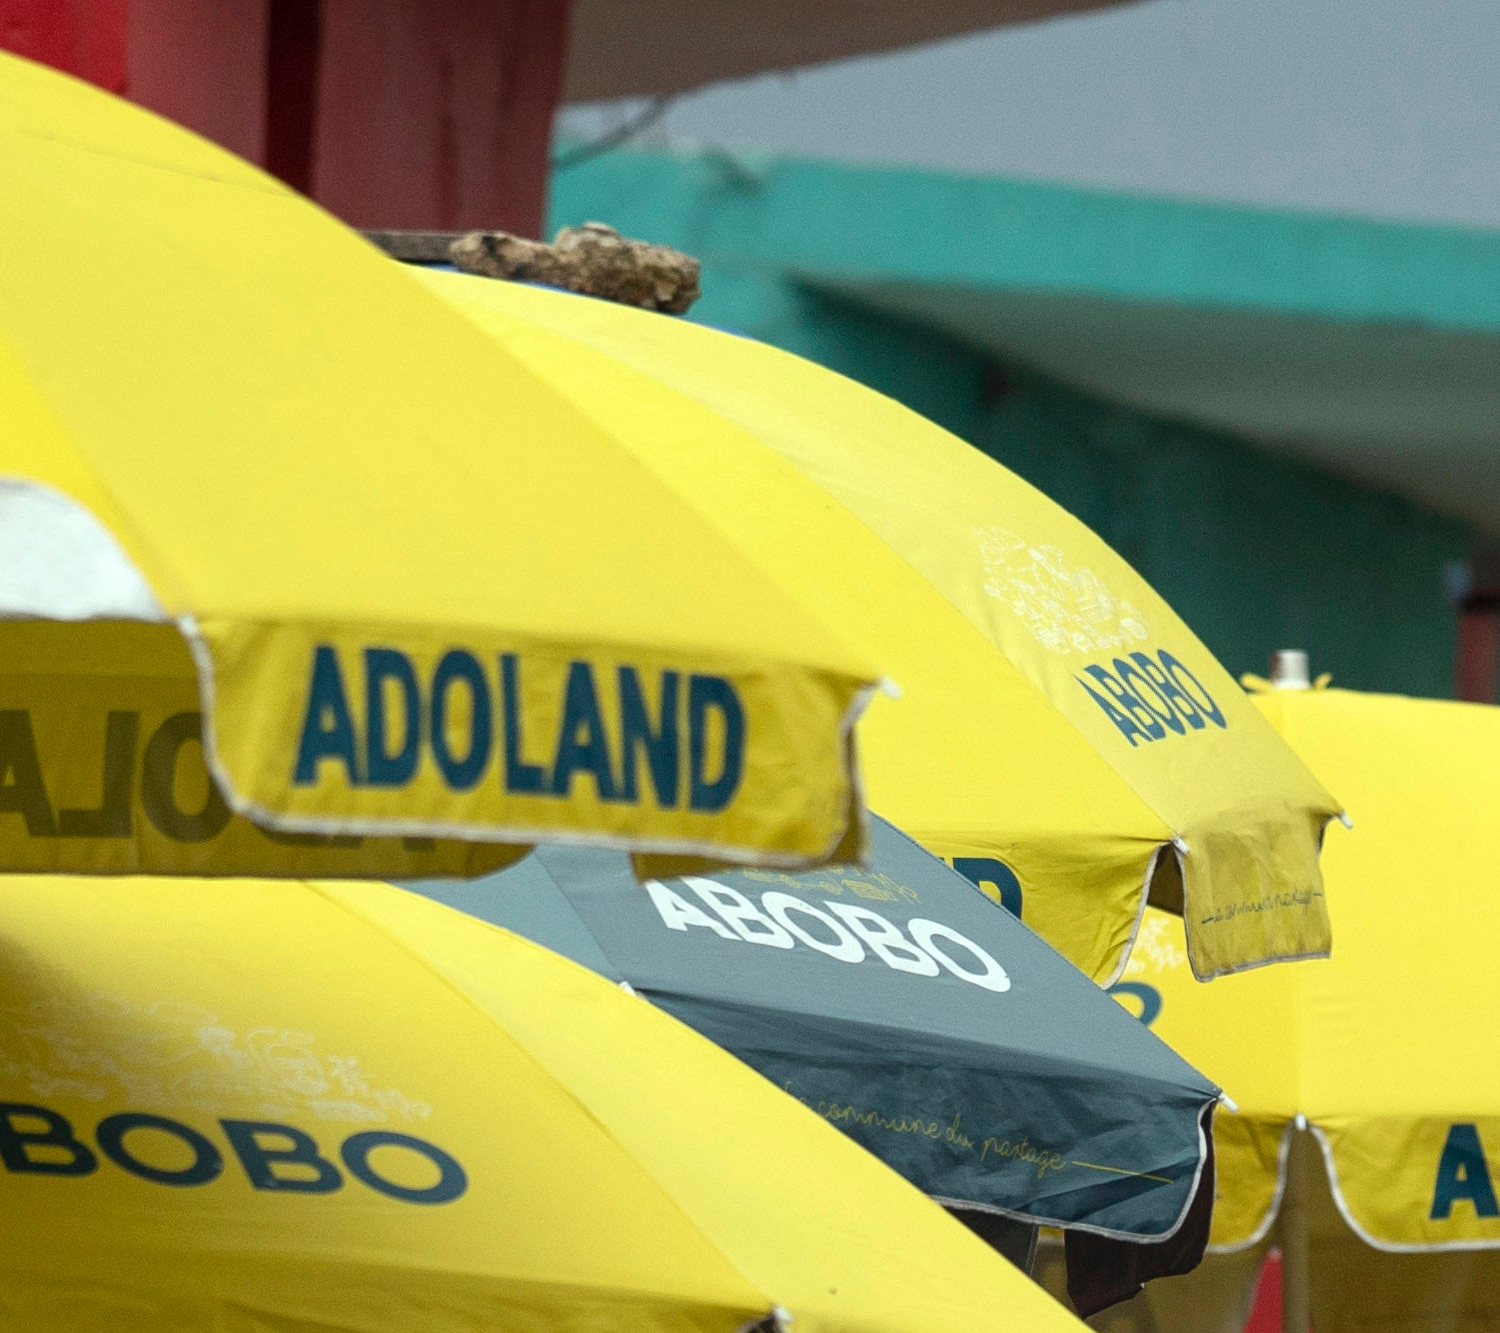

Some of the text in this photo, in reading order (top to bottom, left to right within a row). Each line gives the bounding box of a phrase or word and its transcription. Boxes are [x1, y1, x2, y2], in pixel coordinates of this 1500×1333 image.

[292, 644, 747, 816] ADOLAND
[1073, 648, 1227, 747] ABOBO
[645, 876, 1011, 993] ABOBO
